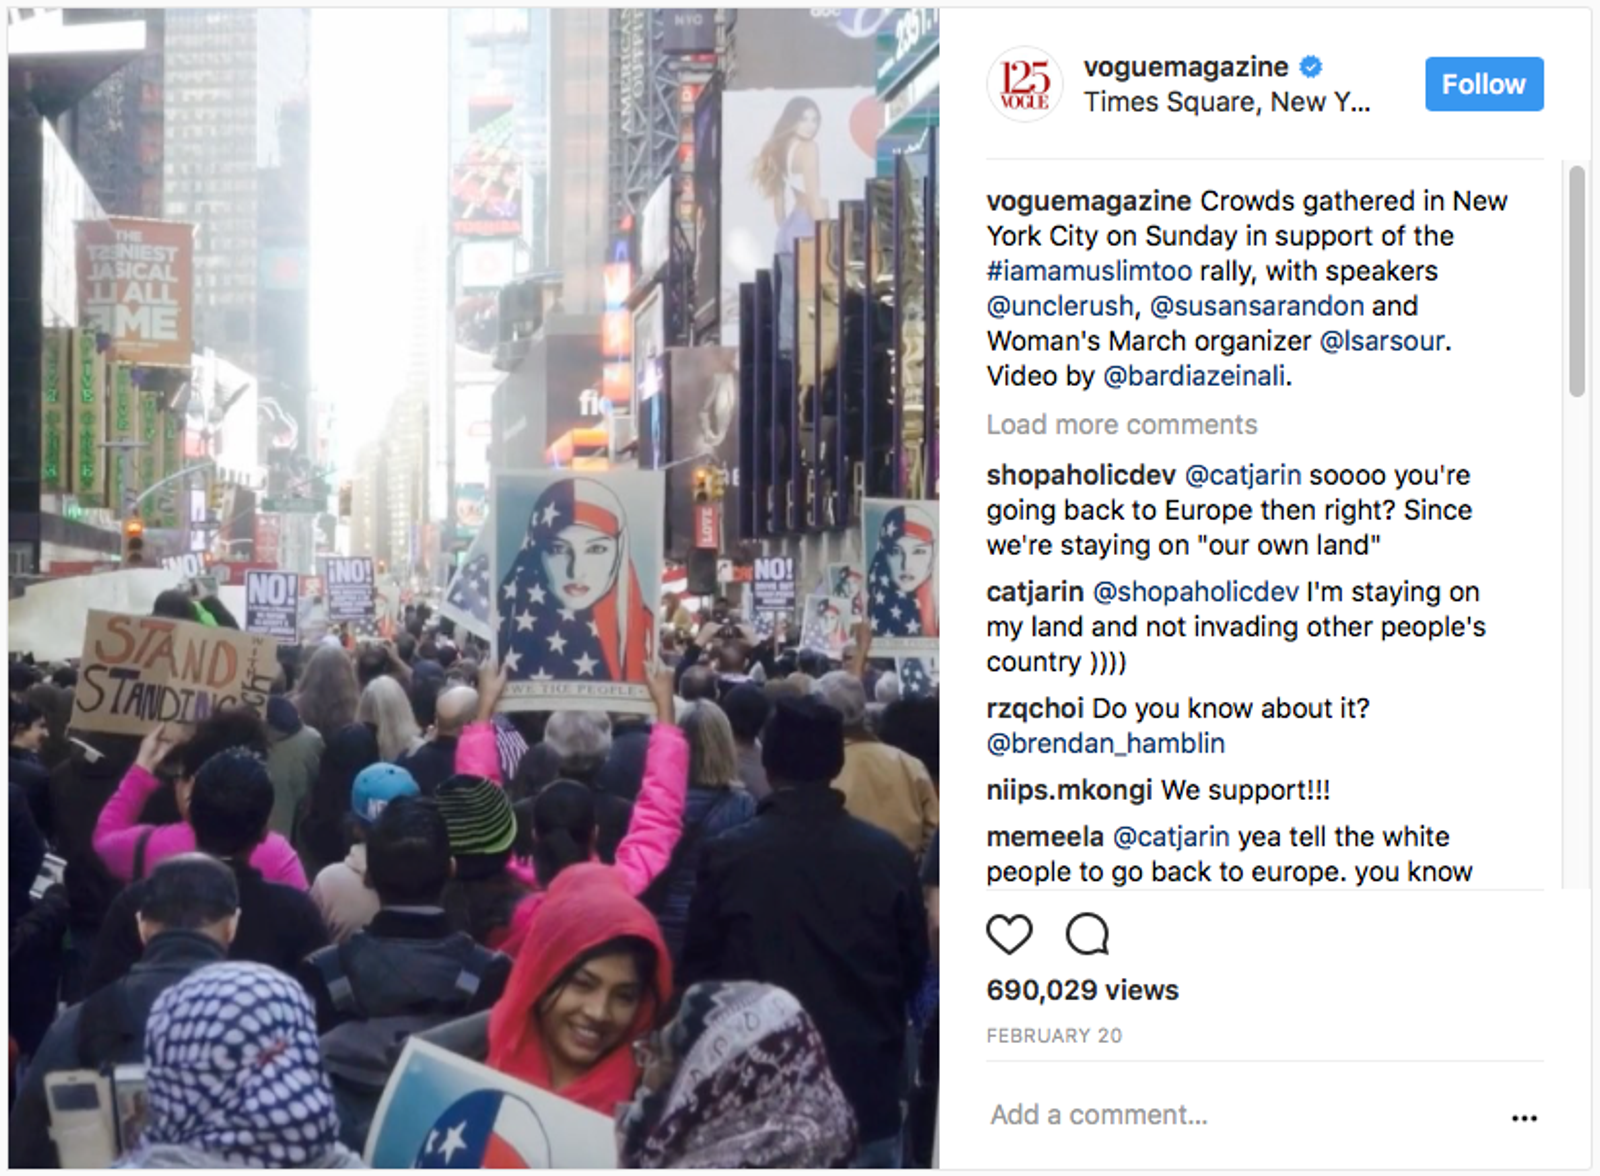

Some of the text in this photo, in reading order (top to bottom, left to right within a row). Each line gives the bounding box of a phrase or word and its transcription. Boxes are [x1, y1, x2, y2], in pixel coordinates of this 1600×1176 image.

[674, 14, 703, 25] NYC
[116, 231, 142, 242] THE
[701, 507, 713, 542] LOVE
[328, 560, 373, 583] ¡NO!
[754, 558, 793, 580] NO!
[249, 574, 295, 605] NO!
[96, 616, 237, 690] STAND
[510, 684, 535, 693] WE
[577, 685, 637, 695] PEOPLE
